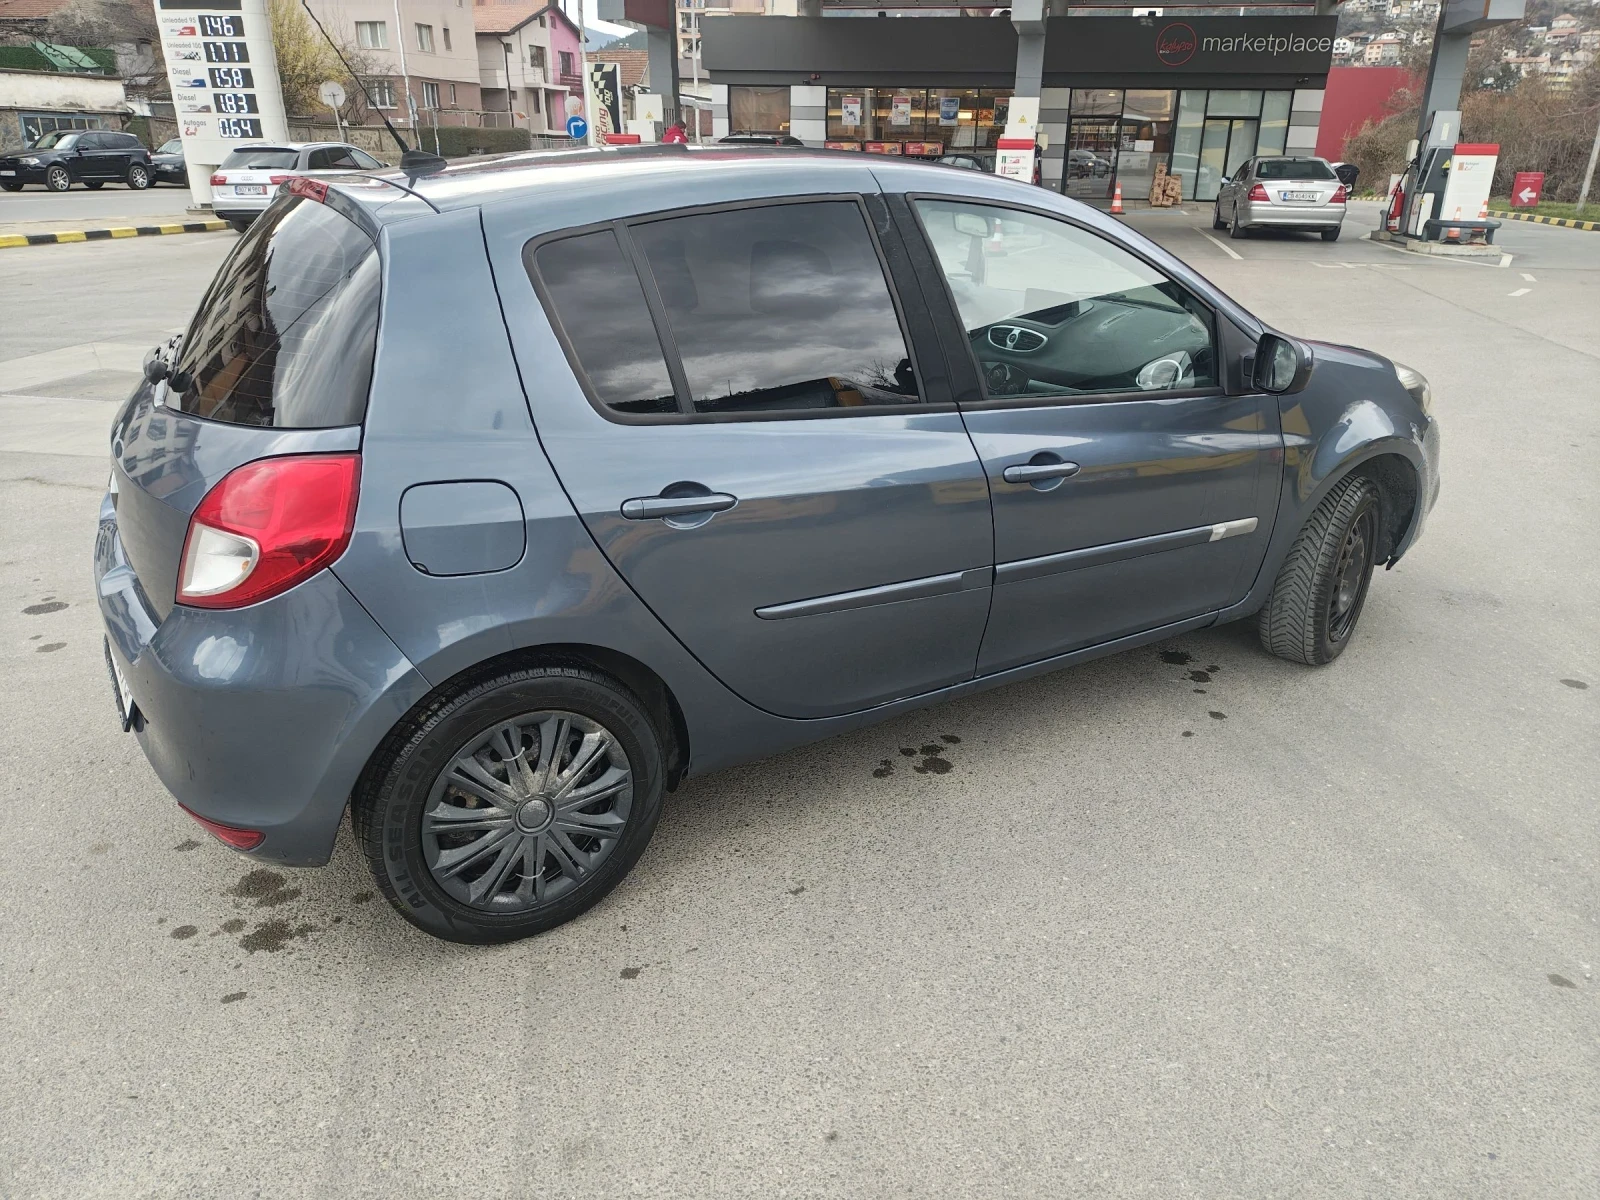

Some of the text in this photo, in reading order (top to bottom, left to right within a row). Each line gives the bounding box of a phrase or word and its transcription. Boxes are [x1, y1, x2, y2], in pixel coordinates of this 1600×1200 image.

[205, 16, 234, 36] 1.46
[210, 43, 239, 62] 1.71
[1202, 32, 1332, 56] marketplace
[172, 68, 192, 76] Diesel
[177, 93, 197, 101] Diesel
[220, 93, 248, 113] 1.83
[219, 119, 253, 137] 0.64
[599, 108, 608, 146] racing
[388, 736, 440, 909] ALL SEASON
